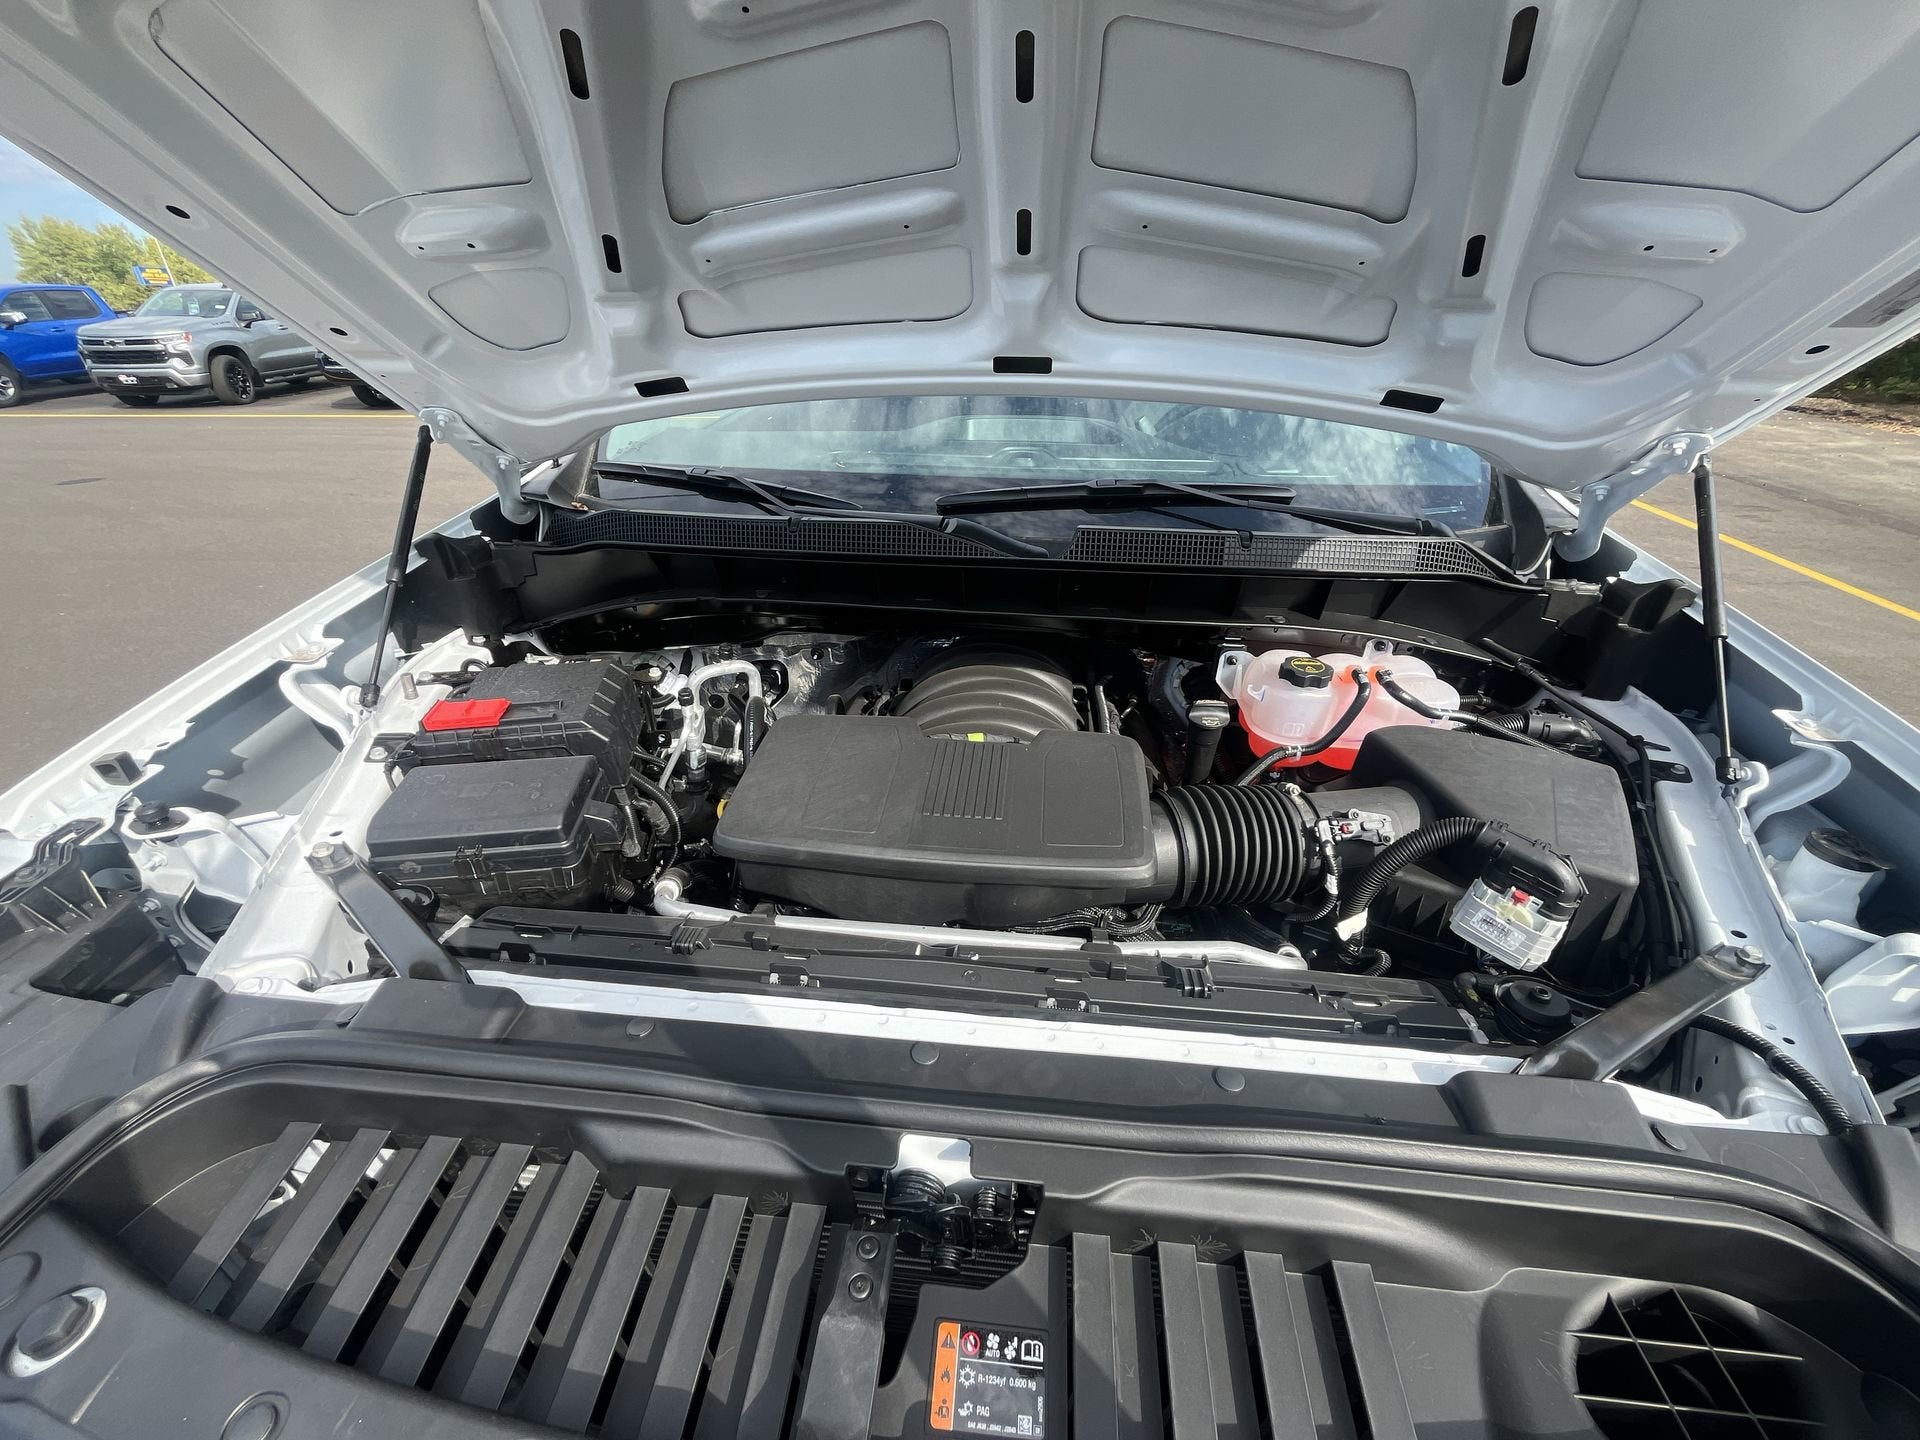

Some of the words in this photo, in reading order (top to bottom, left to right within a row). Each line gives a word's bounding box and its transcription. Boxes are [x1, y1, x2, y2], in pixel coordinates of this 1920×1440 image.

[985, 1348, 1000, 1358] AUTO
[978, 1373, 1006, 1387] R-1234yf
[1009, 1377, 1027, 1388] 0.600
[1028, 1379, 1036, 1391] kg
[976, 1405, 990, 1417] PAG
